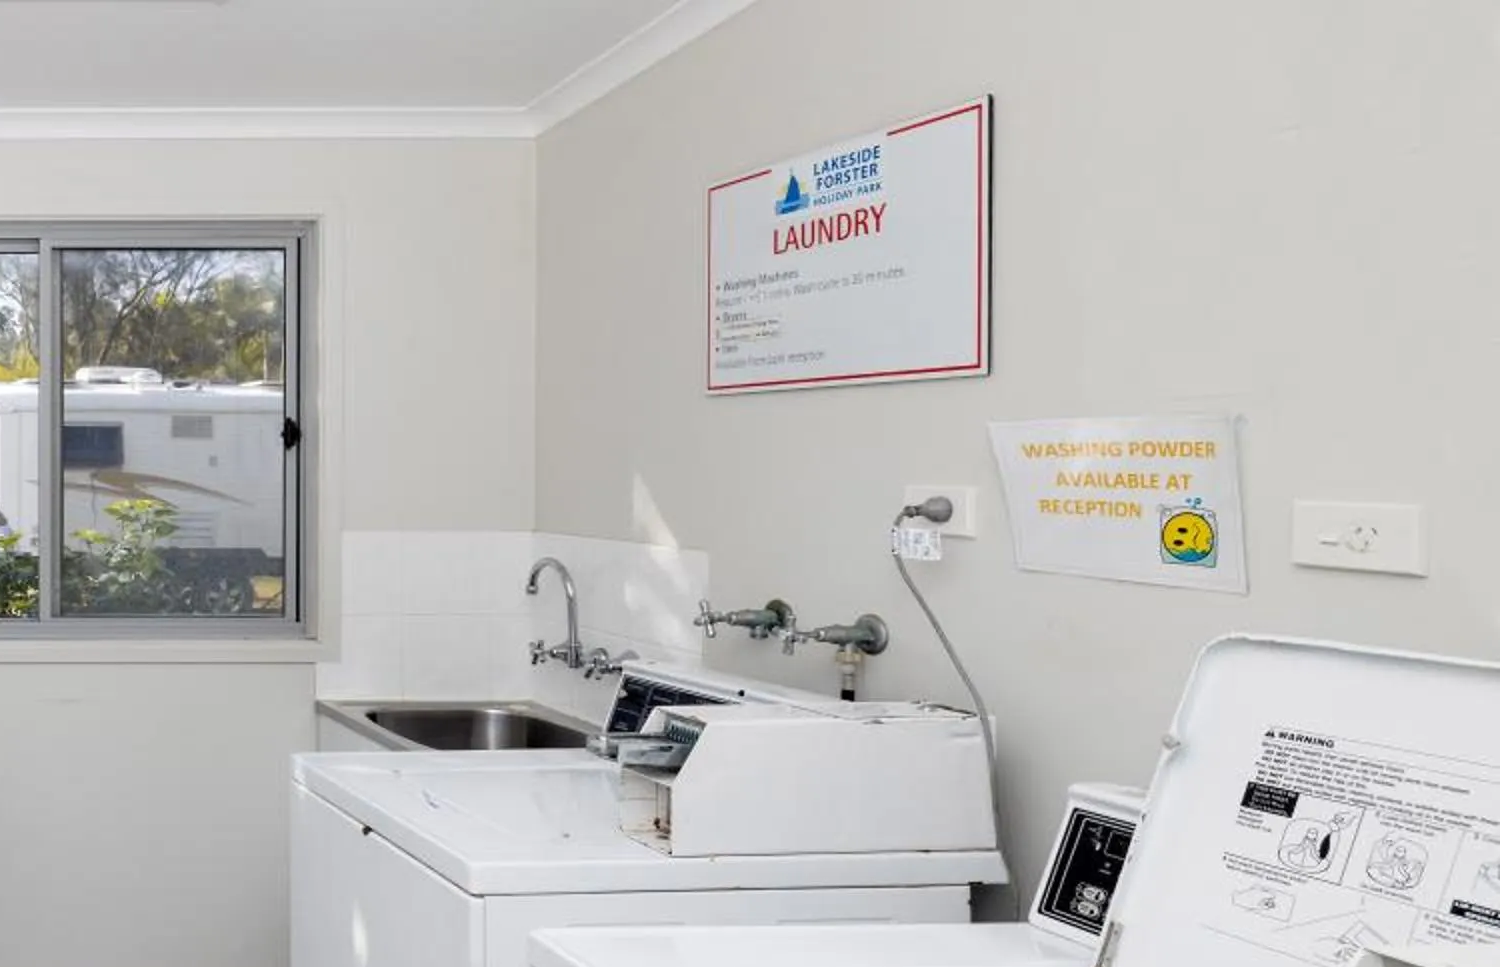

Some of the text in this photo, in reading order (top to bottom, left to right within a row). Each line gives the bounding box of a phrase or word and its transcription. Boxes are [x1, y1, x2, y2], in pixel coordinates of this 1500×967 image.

[813, 145, 881, 177] LAKESIDE
[816, 163, 878, 190] FORSTER
[813, 190, 853, 206] HOLIDAY
[773, 202, 887, 255] LAUNDRY
[1021, 441, 1216, 460] WASHING POWDER
[1056, 472, 1193, 491] AVAILABLE AT
[1038, 499, 1142, 518] RECEPTION
[1278, 731, 1335, 749] WARNING
